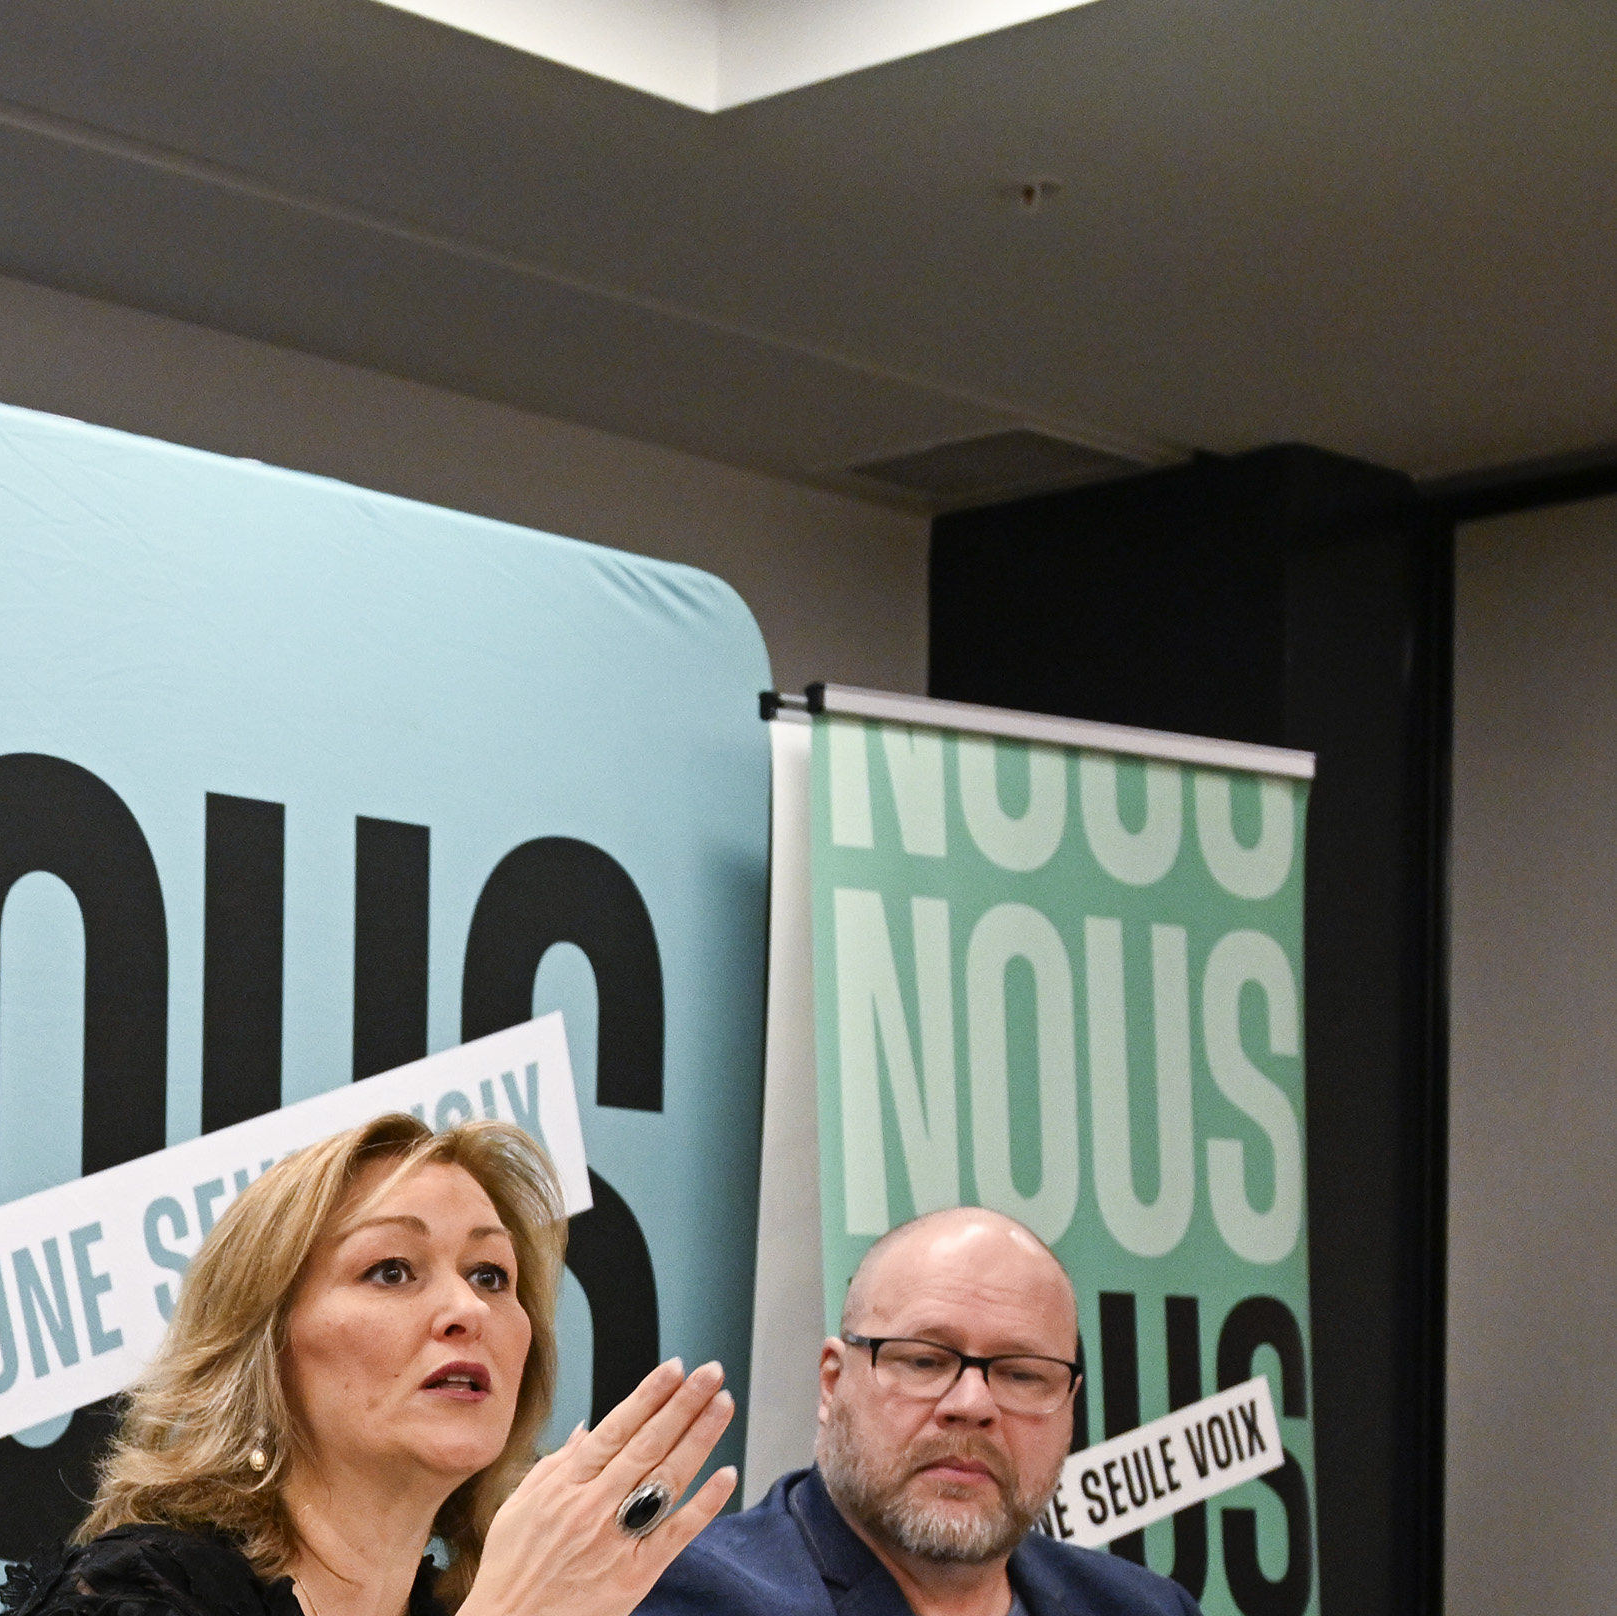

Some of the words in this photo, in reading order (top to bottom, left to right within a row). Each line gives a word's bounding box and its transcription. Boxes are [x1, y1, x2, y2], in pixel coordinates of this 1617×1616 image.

[833, 887, 1304, 1265] NOUS
[1080, 1437, 1182, 1526] SEULE
[1184, 1399, 1267, 1480] VOIX
